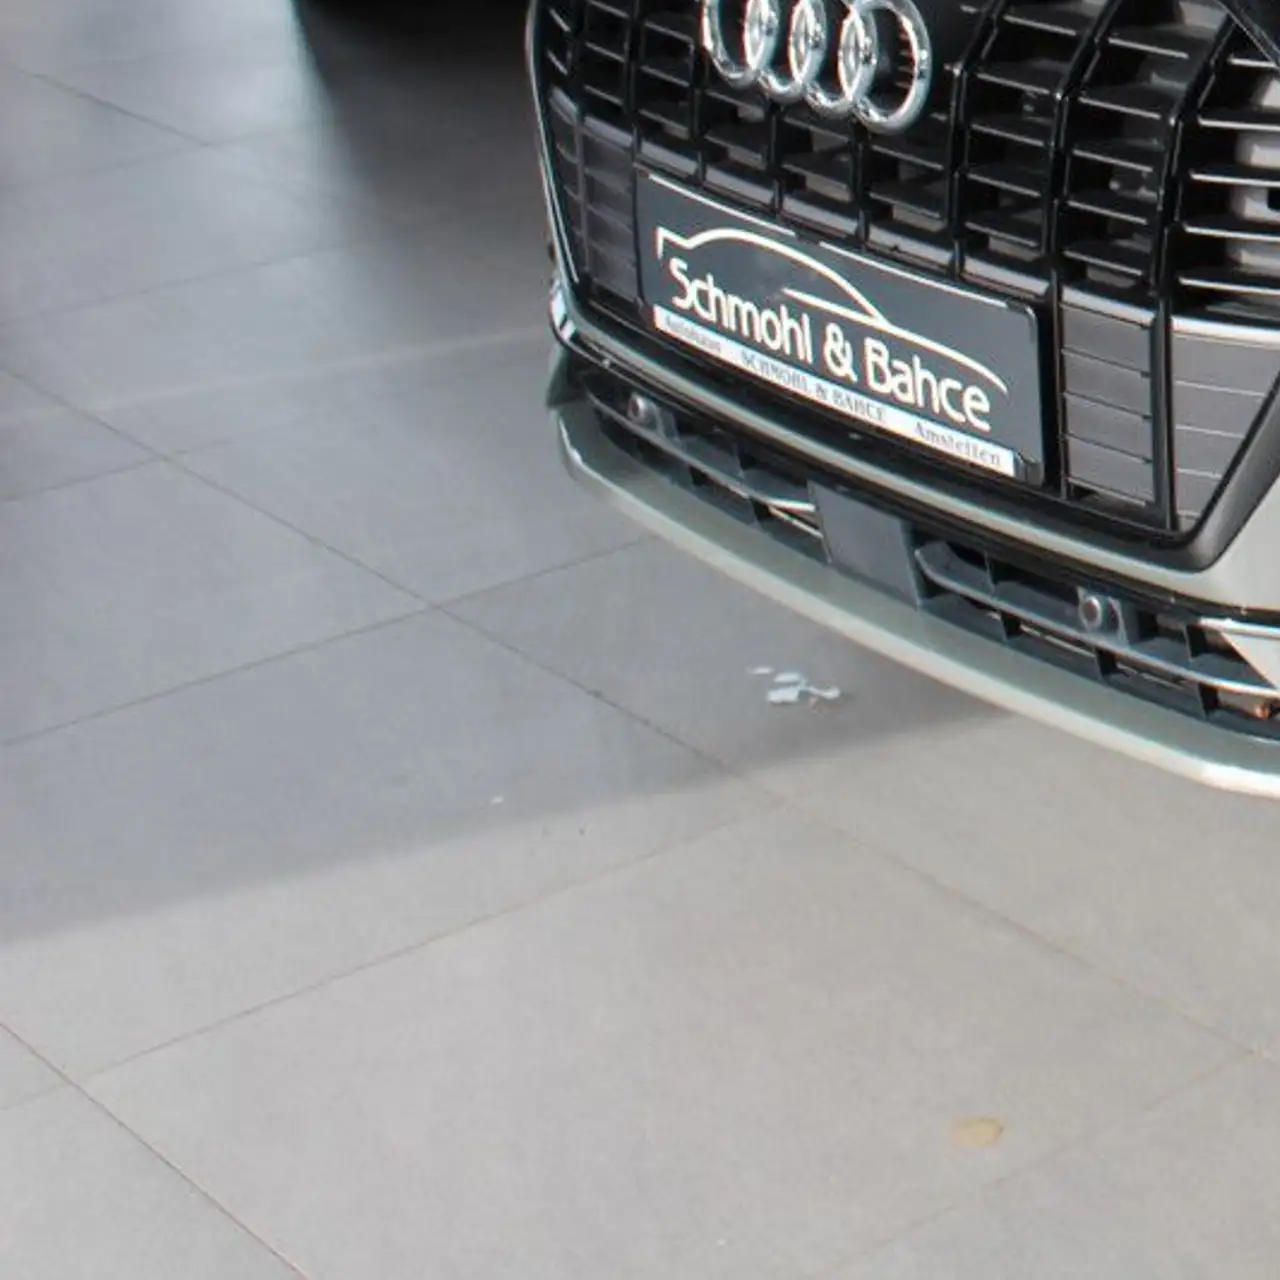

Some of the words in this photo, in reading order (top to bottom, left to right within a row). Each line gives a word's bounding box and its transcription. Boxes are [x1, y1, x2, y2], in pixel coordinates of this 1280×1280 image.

[669, 256, 813, 363] Schmohl
[823, 323, 858, 383] &
[863, 337, 992, 432] Bahce
[914, 421, 1002, 467] Amstetten
